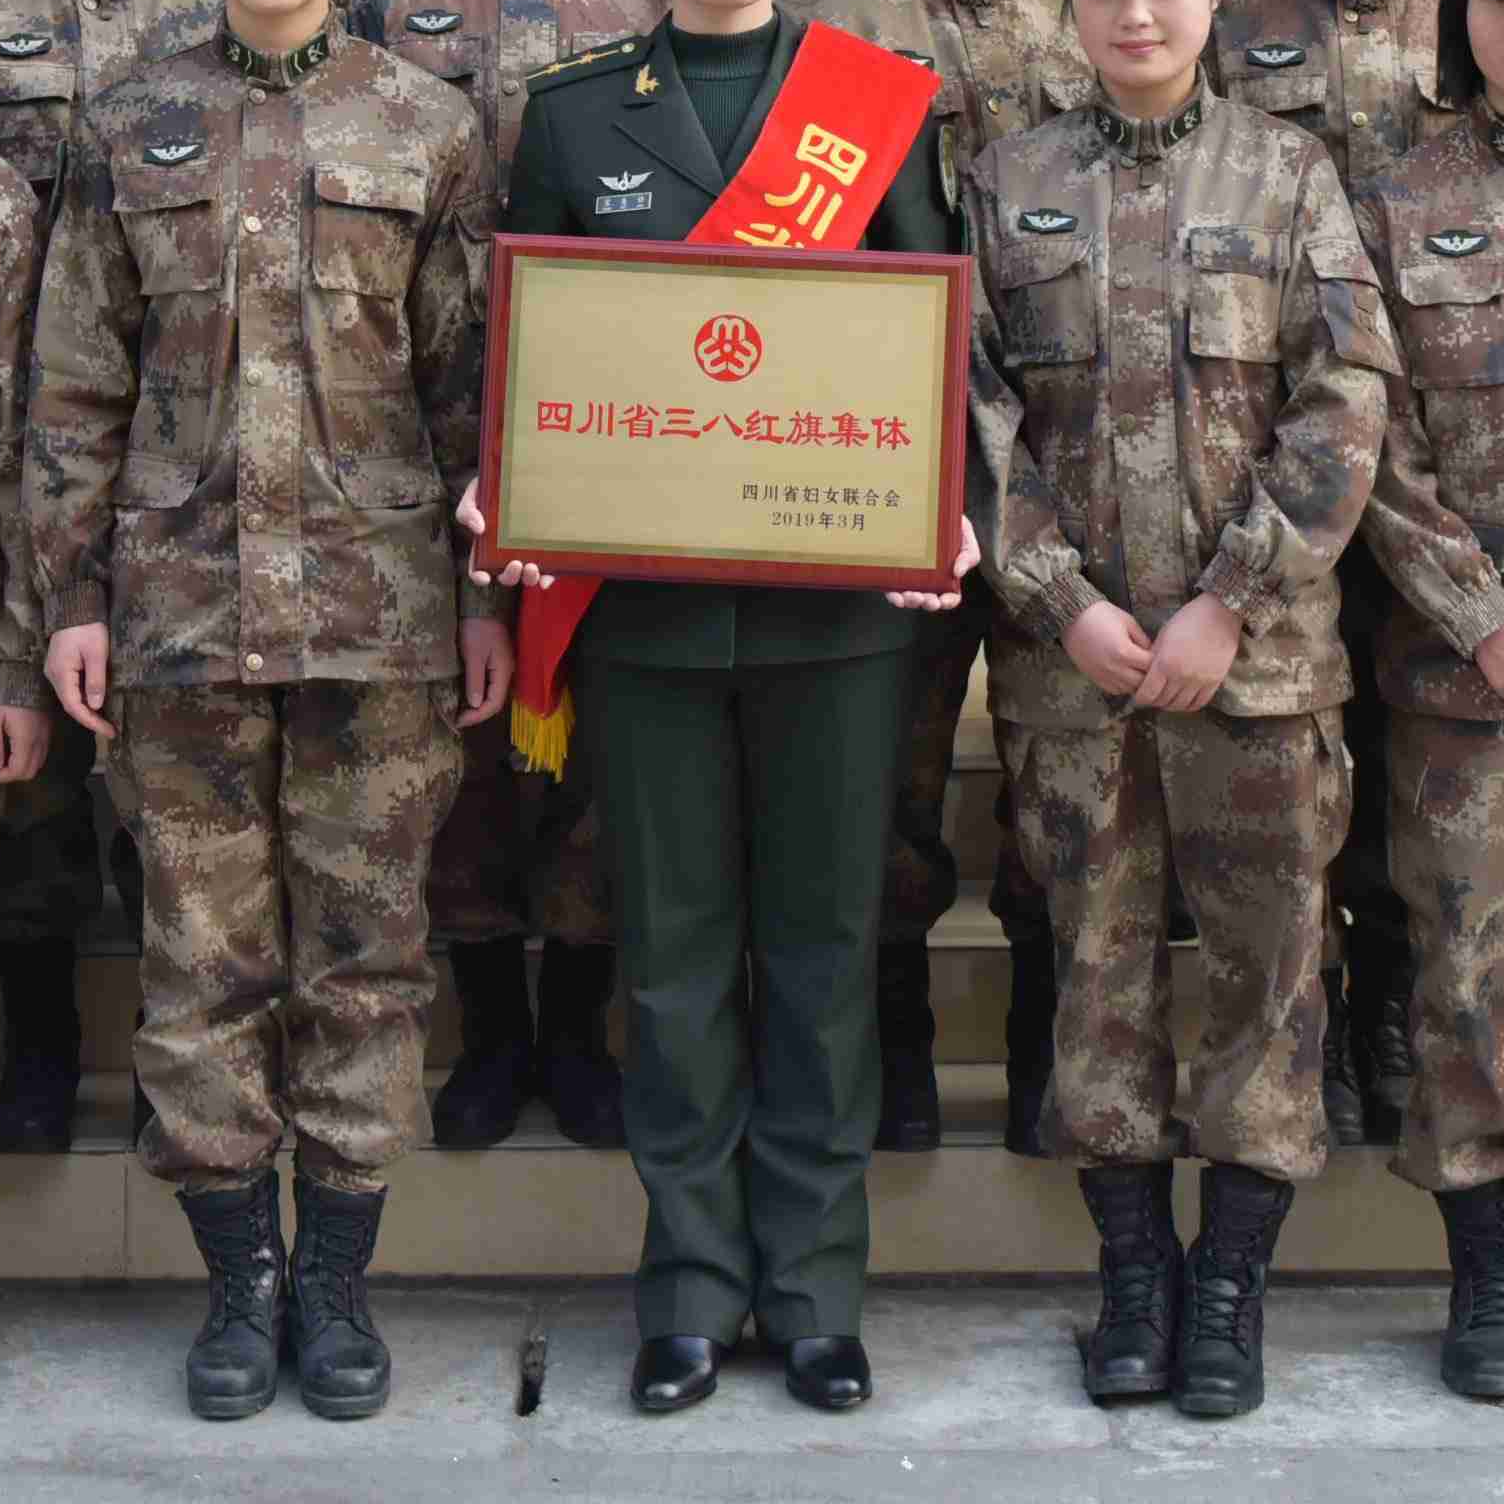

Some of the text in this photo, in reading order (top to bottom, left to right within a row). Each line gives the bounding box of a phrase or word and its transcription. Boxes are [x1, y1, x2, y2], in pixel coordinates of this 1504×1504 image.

[537, 400, 912, 450] 四川省三八红旗集体
[742, 483, 901, 508] 四川省妇女联合会
[771, 510, 866, 532] 2019年3月
